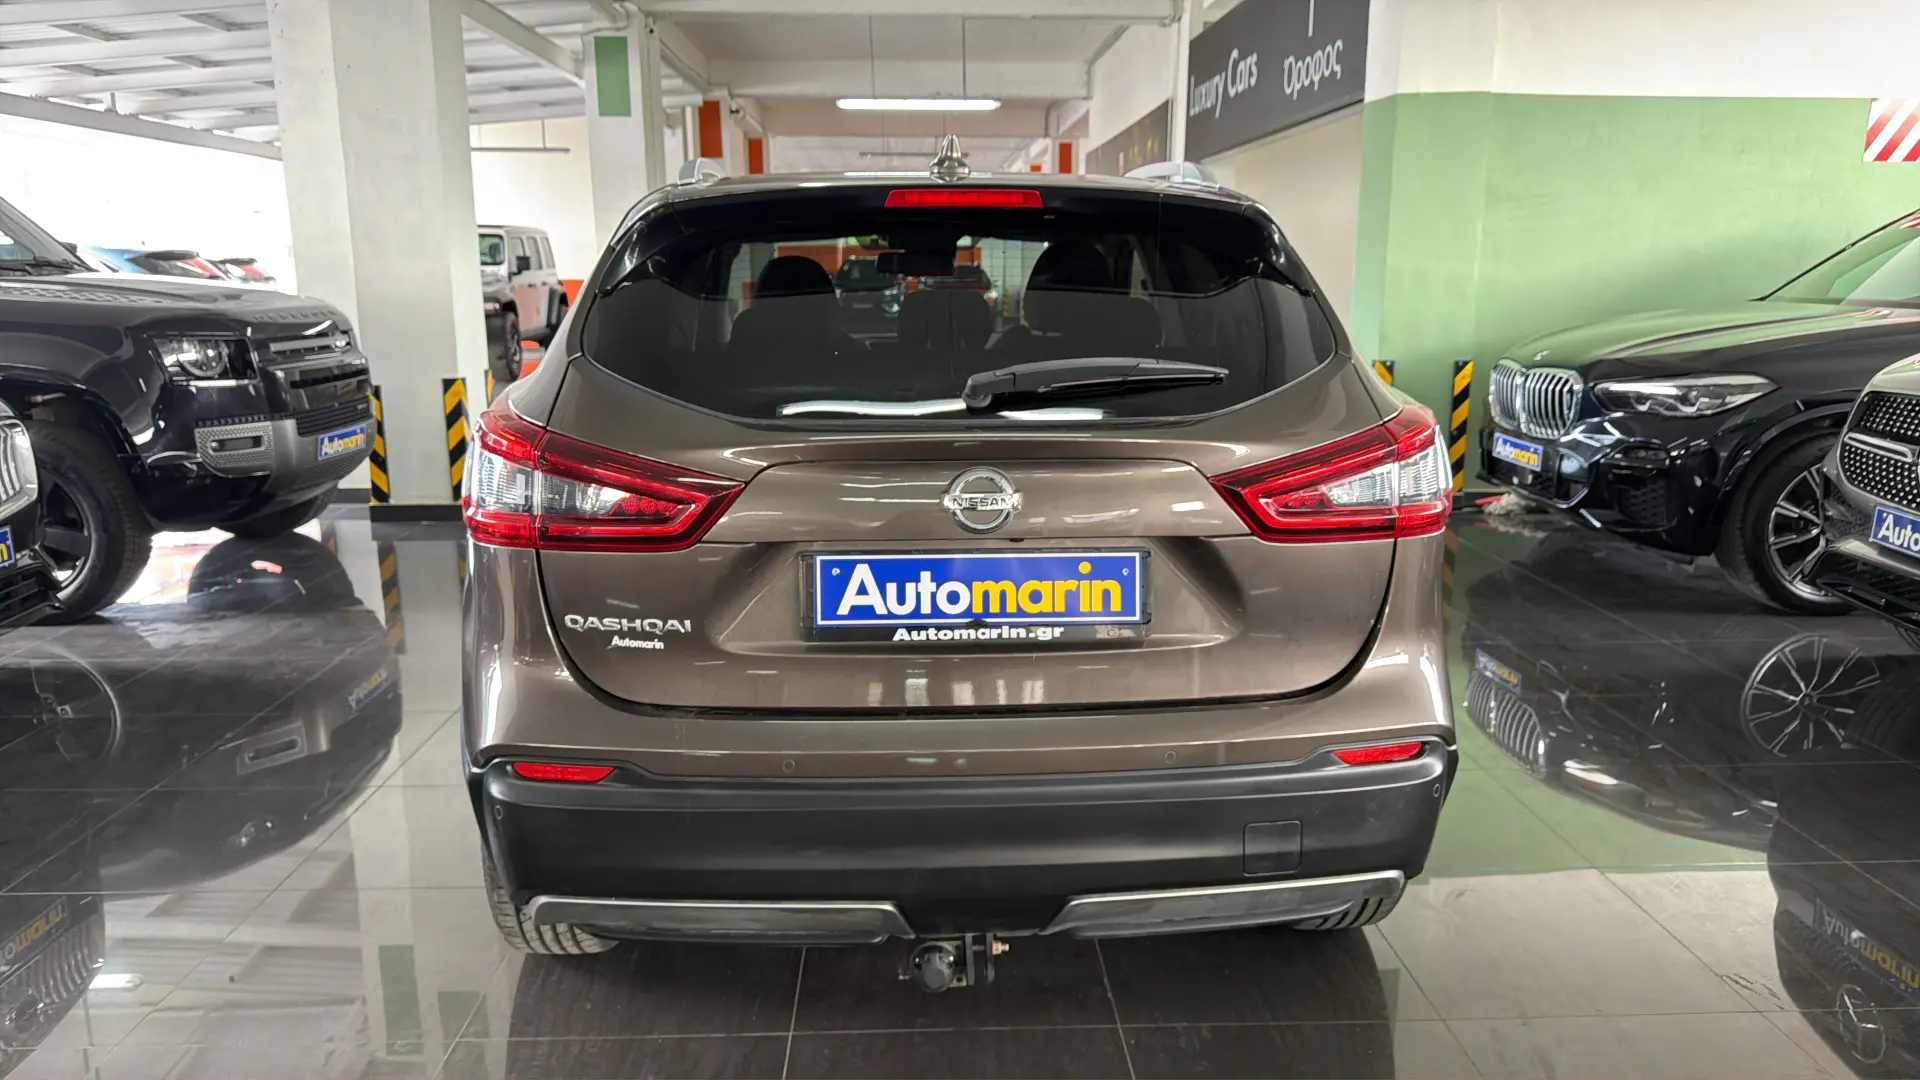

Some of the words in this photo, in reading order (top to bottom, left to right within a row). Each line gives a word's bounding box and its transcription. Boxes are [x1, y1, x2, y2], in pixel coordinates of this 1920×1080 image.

[1189, 70, 1225, 119] Luxury
[1227, 48, 1258, 98] Cars
[322, 430, 364, 457] Automarin
[1495, 437, 1538, 467] Automarin
[952, 497, 1009, 508] NISSAN
[836, 561, 1122, 616] Automarin
[564, 614, 692, 635] QASHQAI
[892, 625, 1064, 642] Automarin.gr
[611, 635, 664, 650] Automarin
